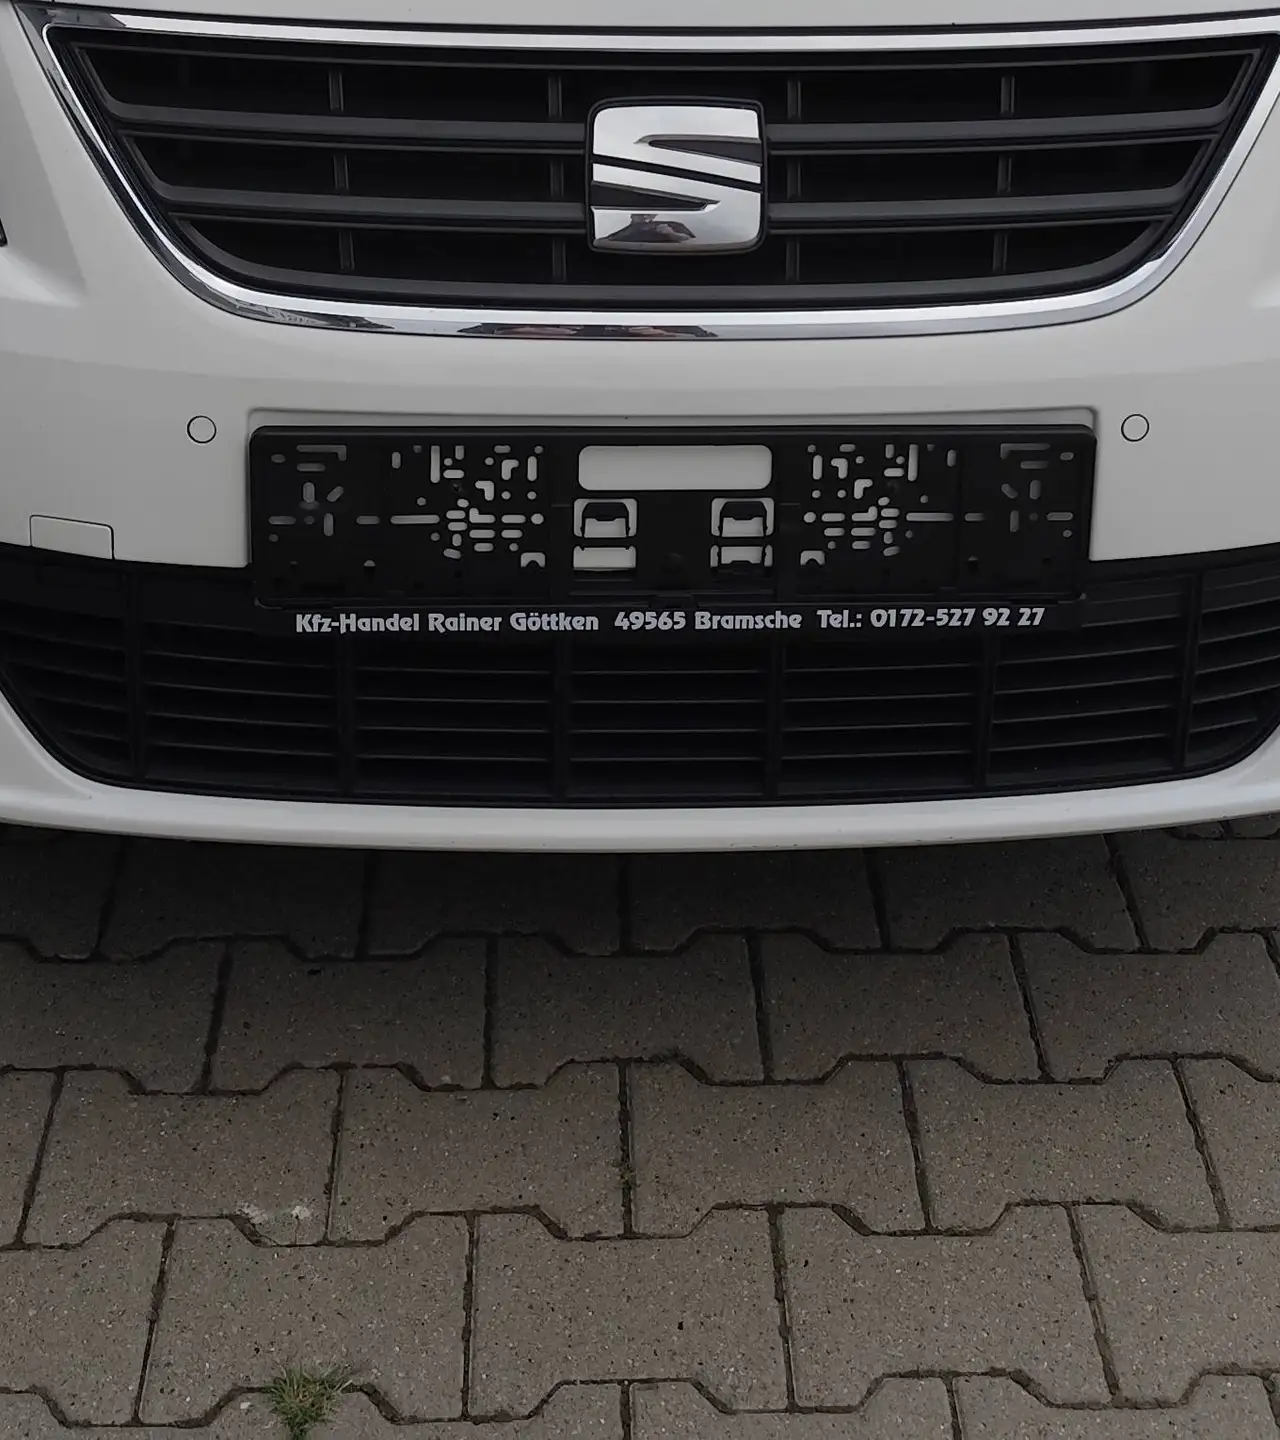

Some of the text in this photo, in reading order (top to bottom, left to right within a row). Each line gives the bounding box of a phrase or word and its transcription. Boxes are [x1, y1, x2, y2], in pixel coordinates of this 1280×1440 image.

[296, 607, 1046, 635] Kfz-Handel Rainer Göttken 49565 Bramsche Tel.: 0172-527 92 27
